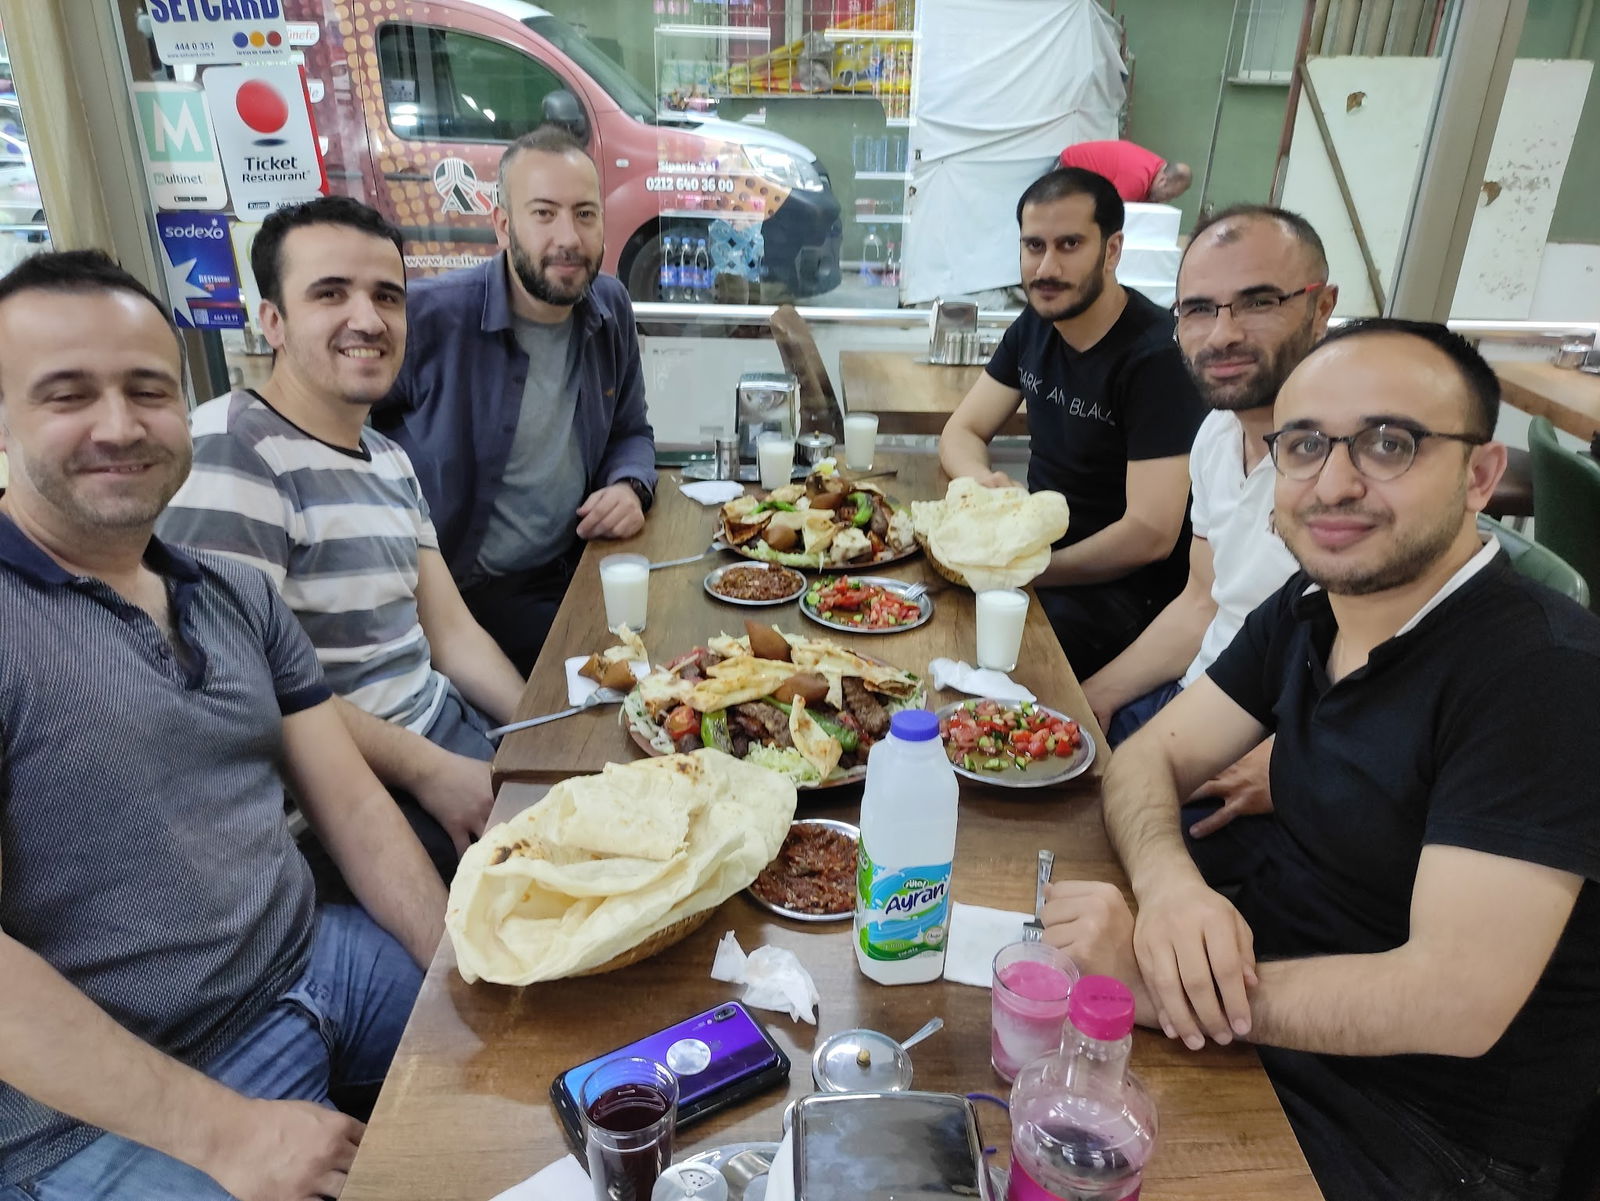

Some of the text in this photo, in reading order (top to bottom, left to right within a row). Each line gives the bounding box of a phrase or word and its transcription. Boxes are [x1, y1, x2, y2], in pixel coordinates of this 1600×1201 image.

[151, 0, 280, 23] SETCARD
[244, 156, 298, 171] Ticket
[153, 172, 203, 185] Multinet
[242, 170, 307, 183] Restaurant
[645, 176, 734, 192] 0212 640 36 00
[165, 222, 224, 239] sodexo
[885, 883, 945, 915] Ayran
